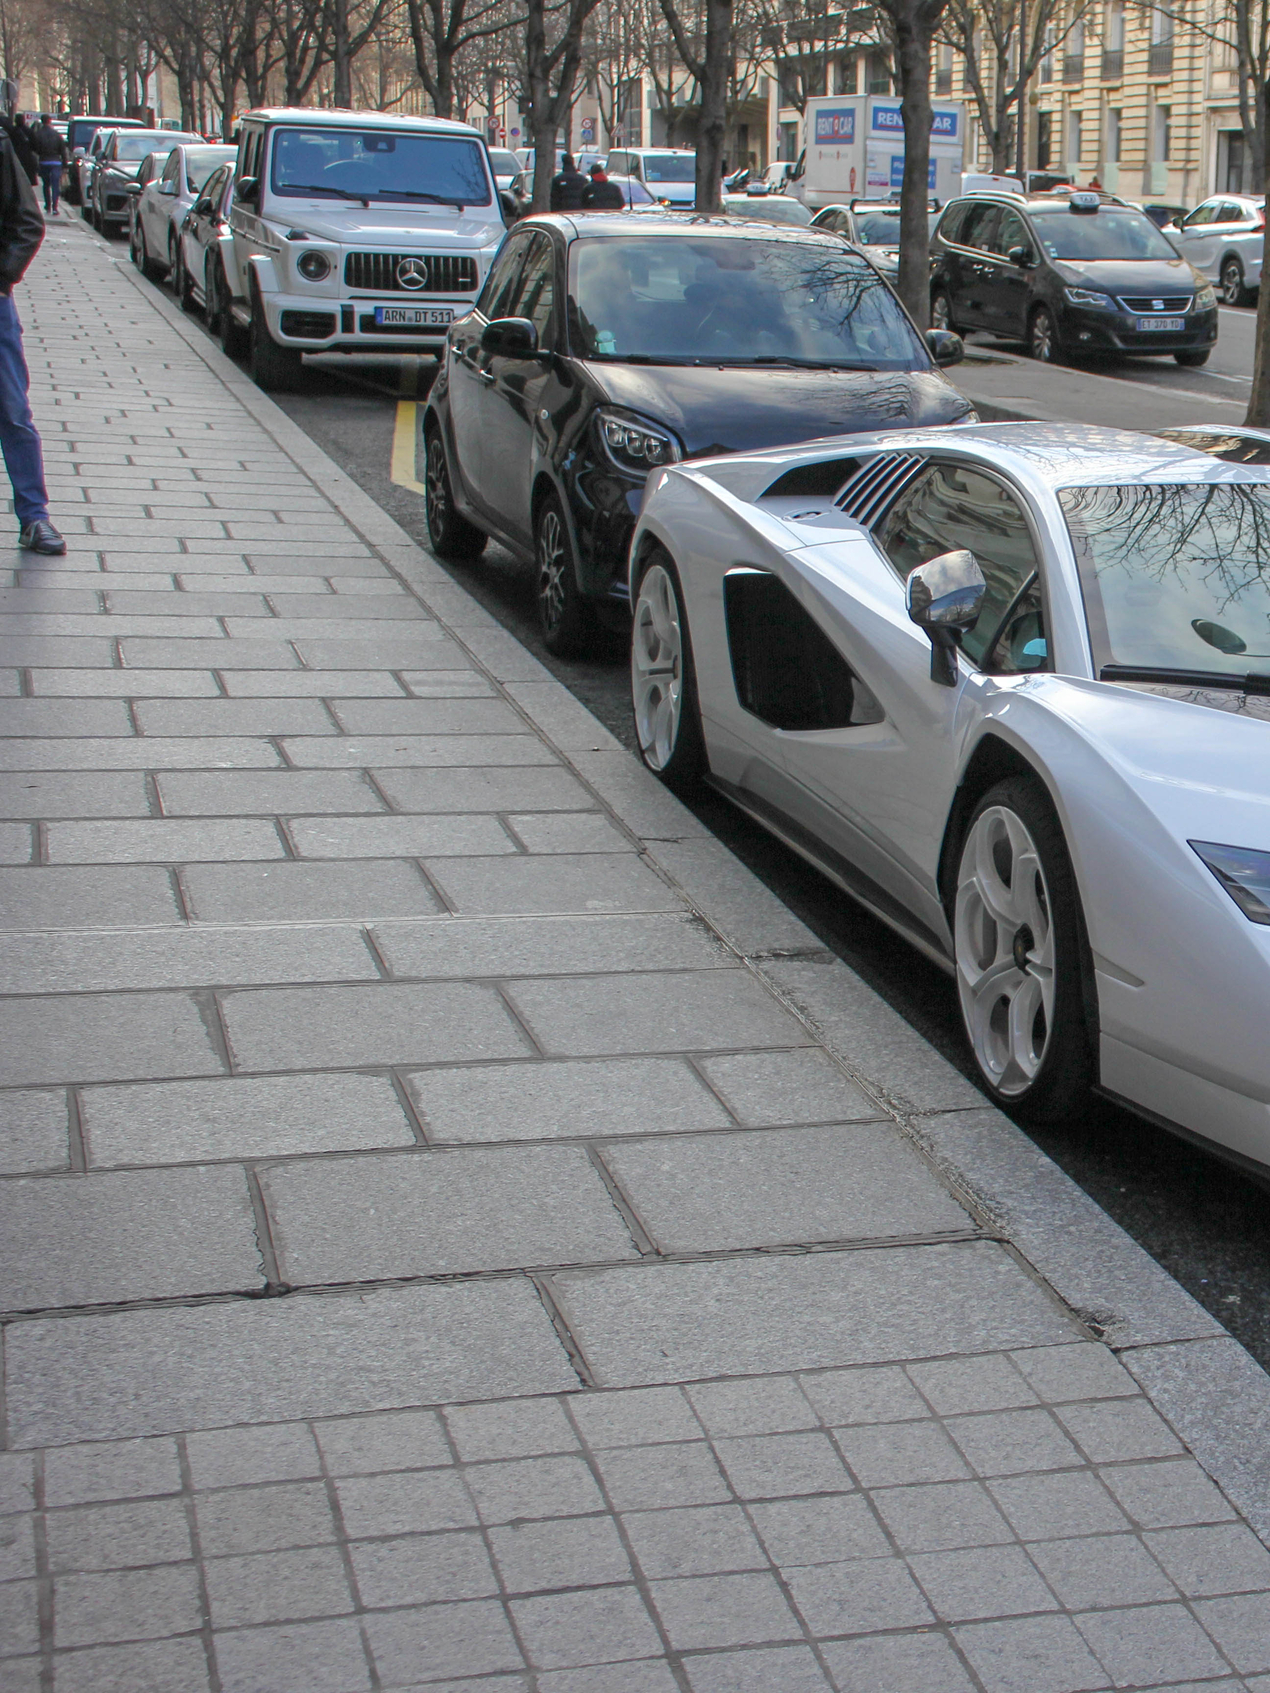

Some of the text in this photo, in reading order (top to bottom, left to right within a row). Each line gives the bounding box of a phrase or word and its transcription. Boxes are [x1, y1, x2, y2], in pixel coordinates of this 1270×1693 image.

[817, 117, 834, 134] RENT
[840, 116, 853, 134] CAR
[878, 112, 952, 130] REN AR
[384, 310, 452, 323] ARN DT 511
